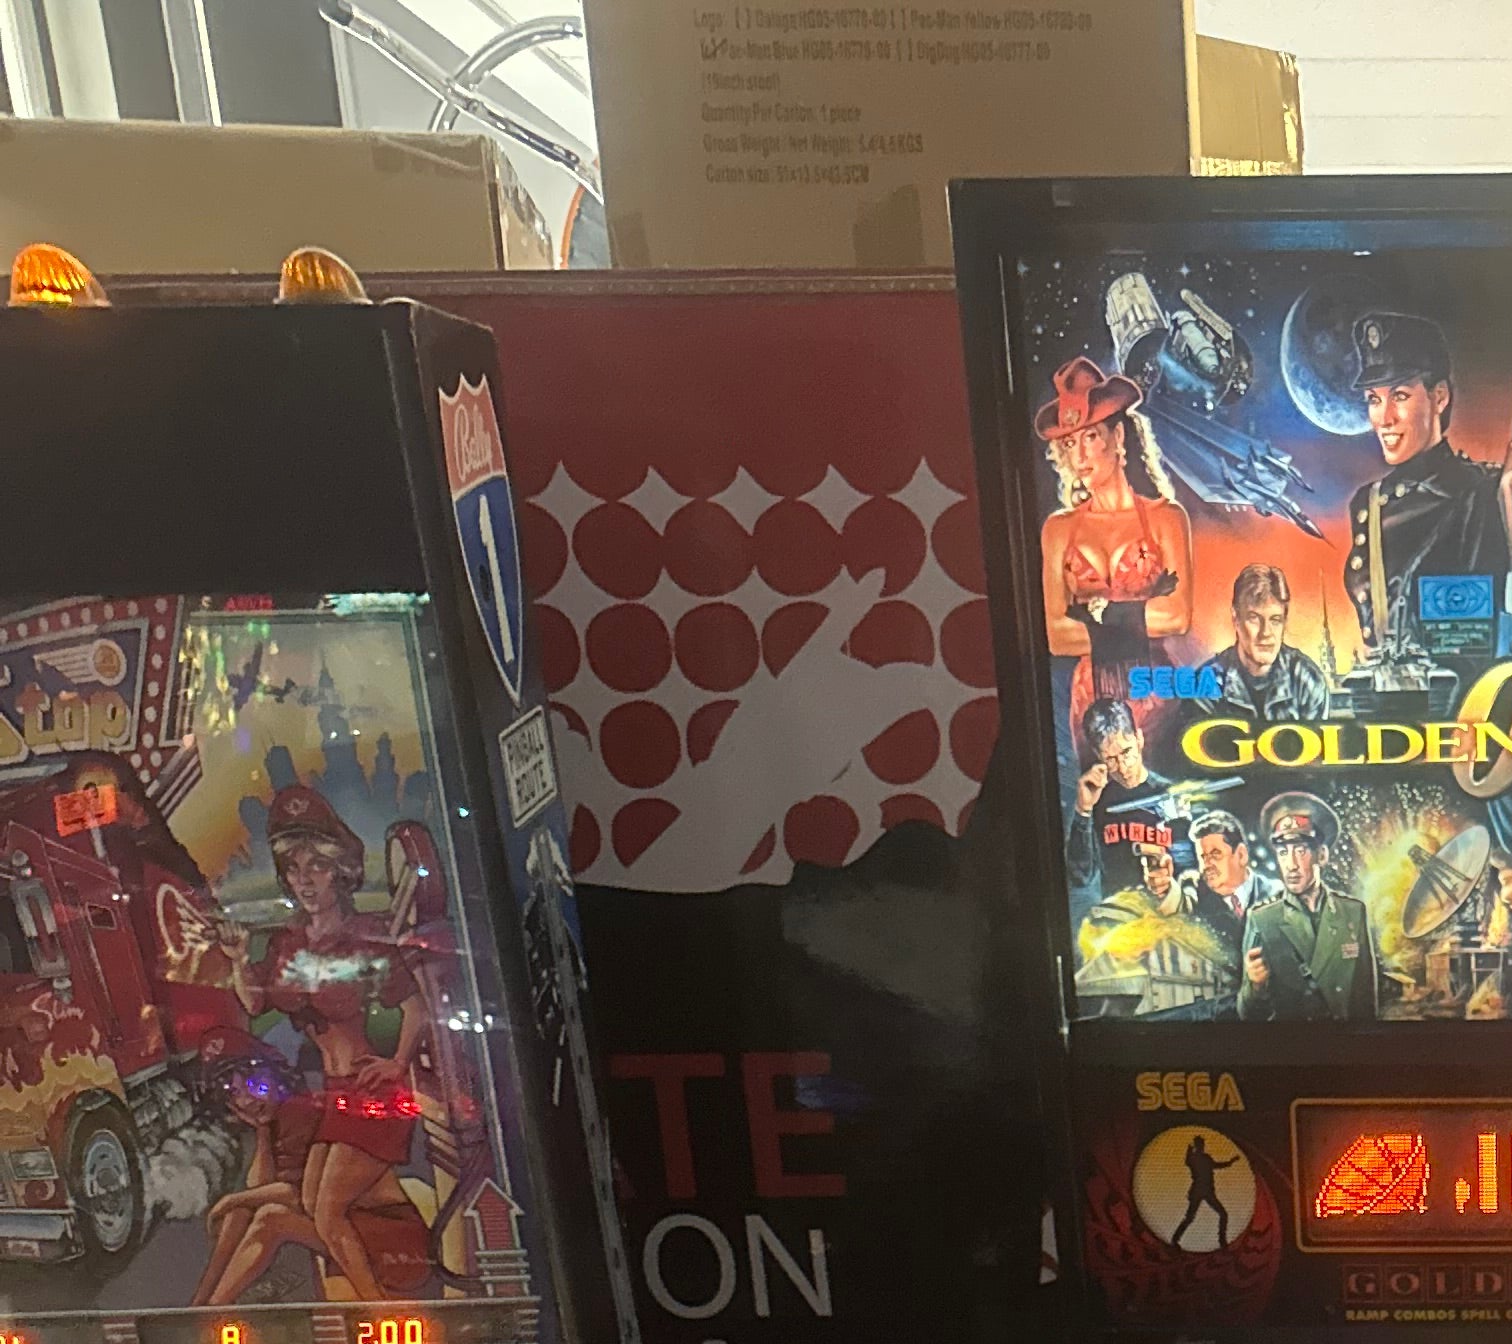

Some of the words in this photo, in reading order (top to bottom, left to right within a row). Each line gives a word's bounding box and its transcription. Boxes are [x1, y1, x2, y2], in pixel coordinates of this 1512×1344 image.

[1128, 664, 1222, 700] SEGA
[0, 664, 133, 765] top
[1104, 822, 1172, 848] WIRED
[1135, 1072, 1244, 1112] SEGA
[611, 1051, 846, 1200] TE
[1345, 1308, 1389, 1321] RAMP
[1393, 1308, 1457, 1321] COMBOS
[1461, 1308, 1501, 1321] SPELL
